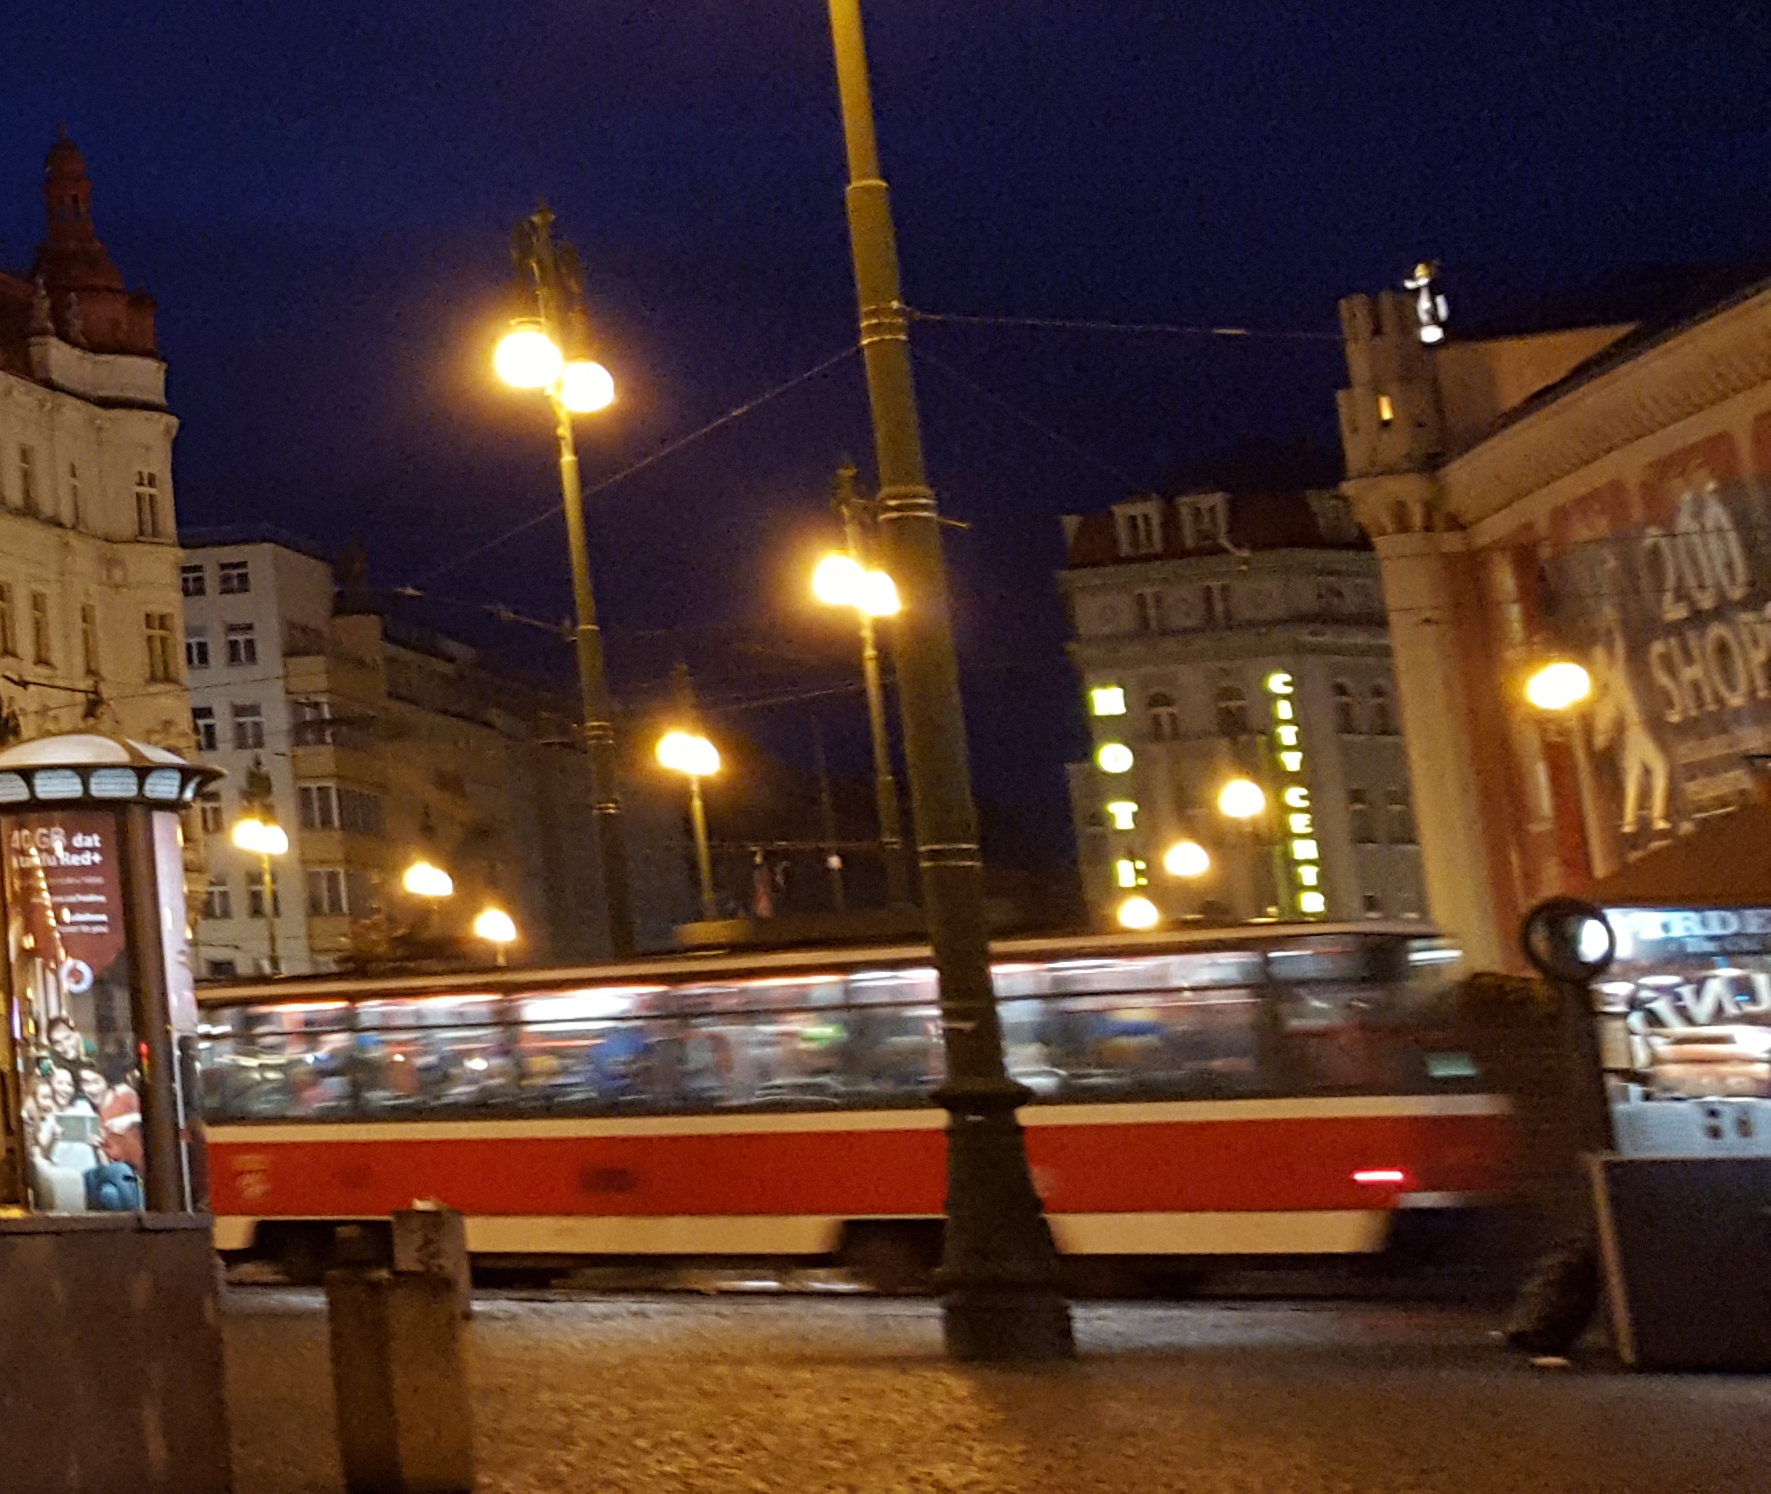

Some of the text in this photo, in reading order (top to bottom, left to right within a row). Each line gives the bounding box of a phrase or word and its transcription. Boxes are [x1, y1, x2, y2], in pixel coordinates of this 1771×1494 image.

[1267, 673, 1303, 773] CITY
[1091, 686, 1148, 889] HOTE
[71, 832, 102, 849] dat
